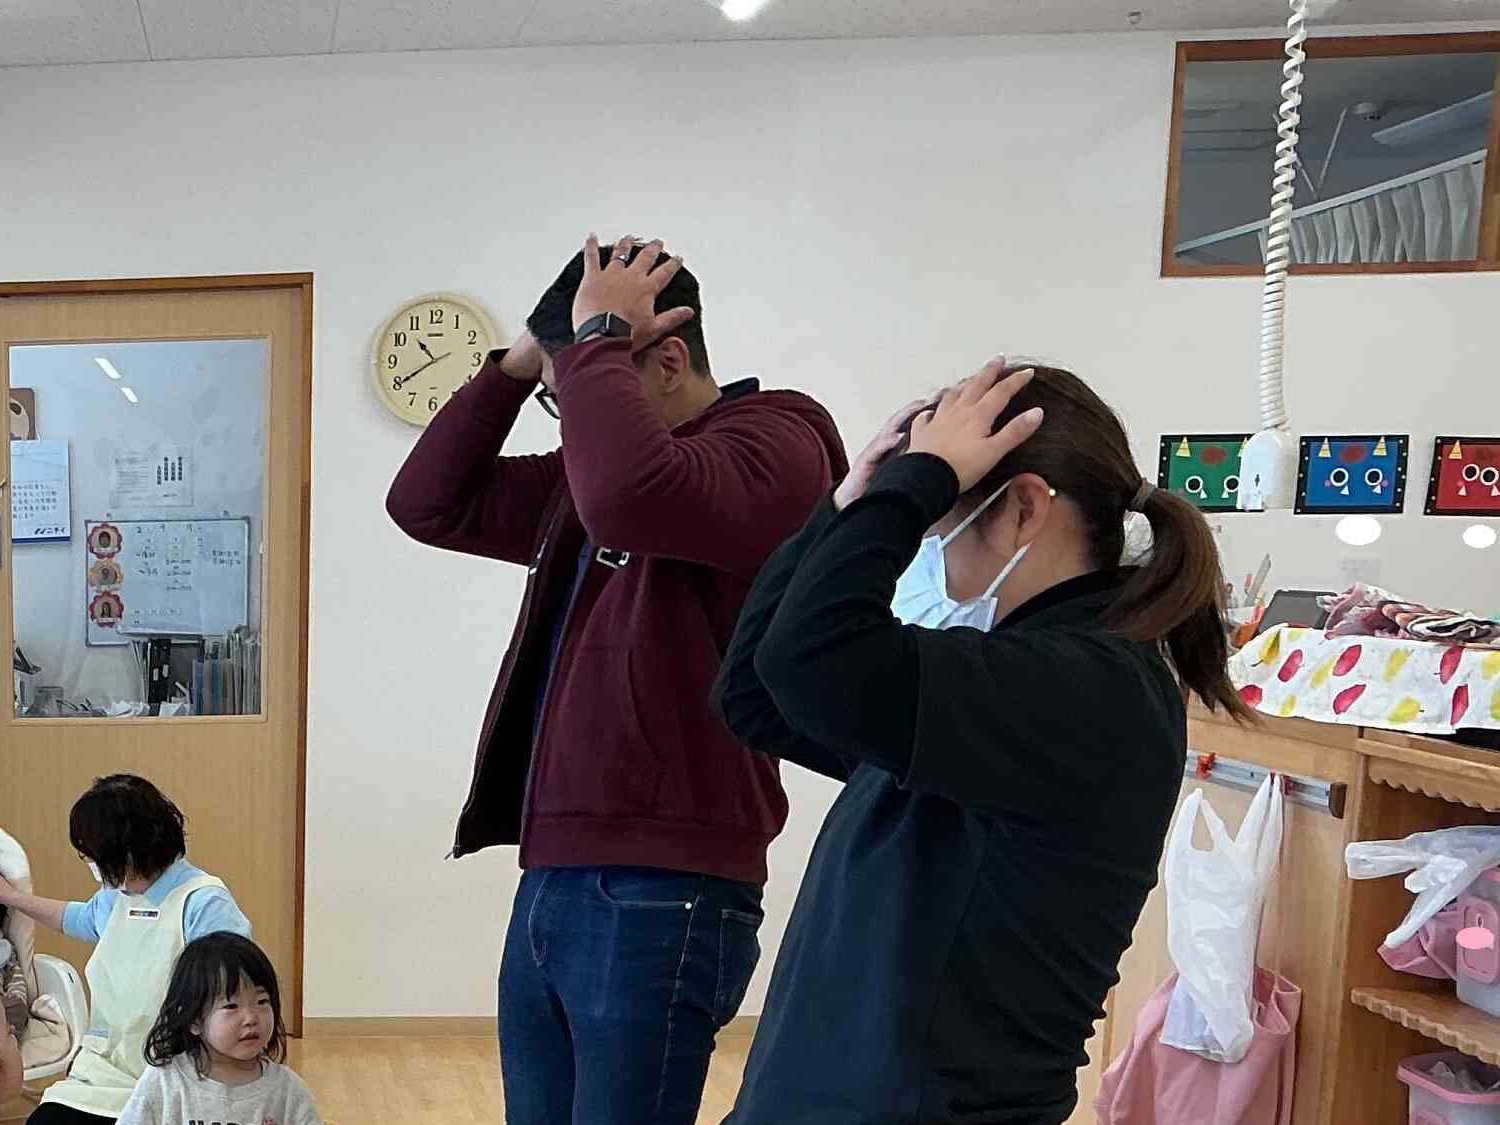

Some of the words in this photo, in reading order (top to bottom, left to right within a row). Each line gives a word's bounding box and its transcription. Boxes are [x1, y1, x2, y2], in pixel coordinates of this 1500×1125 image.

[409, 315, 420, 331] 11
[429, 309, 444, 324] 12
[453, 314, 460, 330] 1
[393, 331, 407, 347] 10
[467, 330, 477, 345] 2
[388, 354, 398, 369] 9
[471, 352, 482, 367] 3
[392, 375, 402, 391] 8
[408, 391, 417, 407] 7
[428, 396, 438, 412] 6
